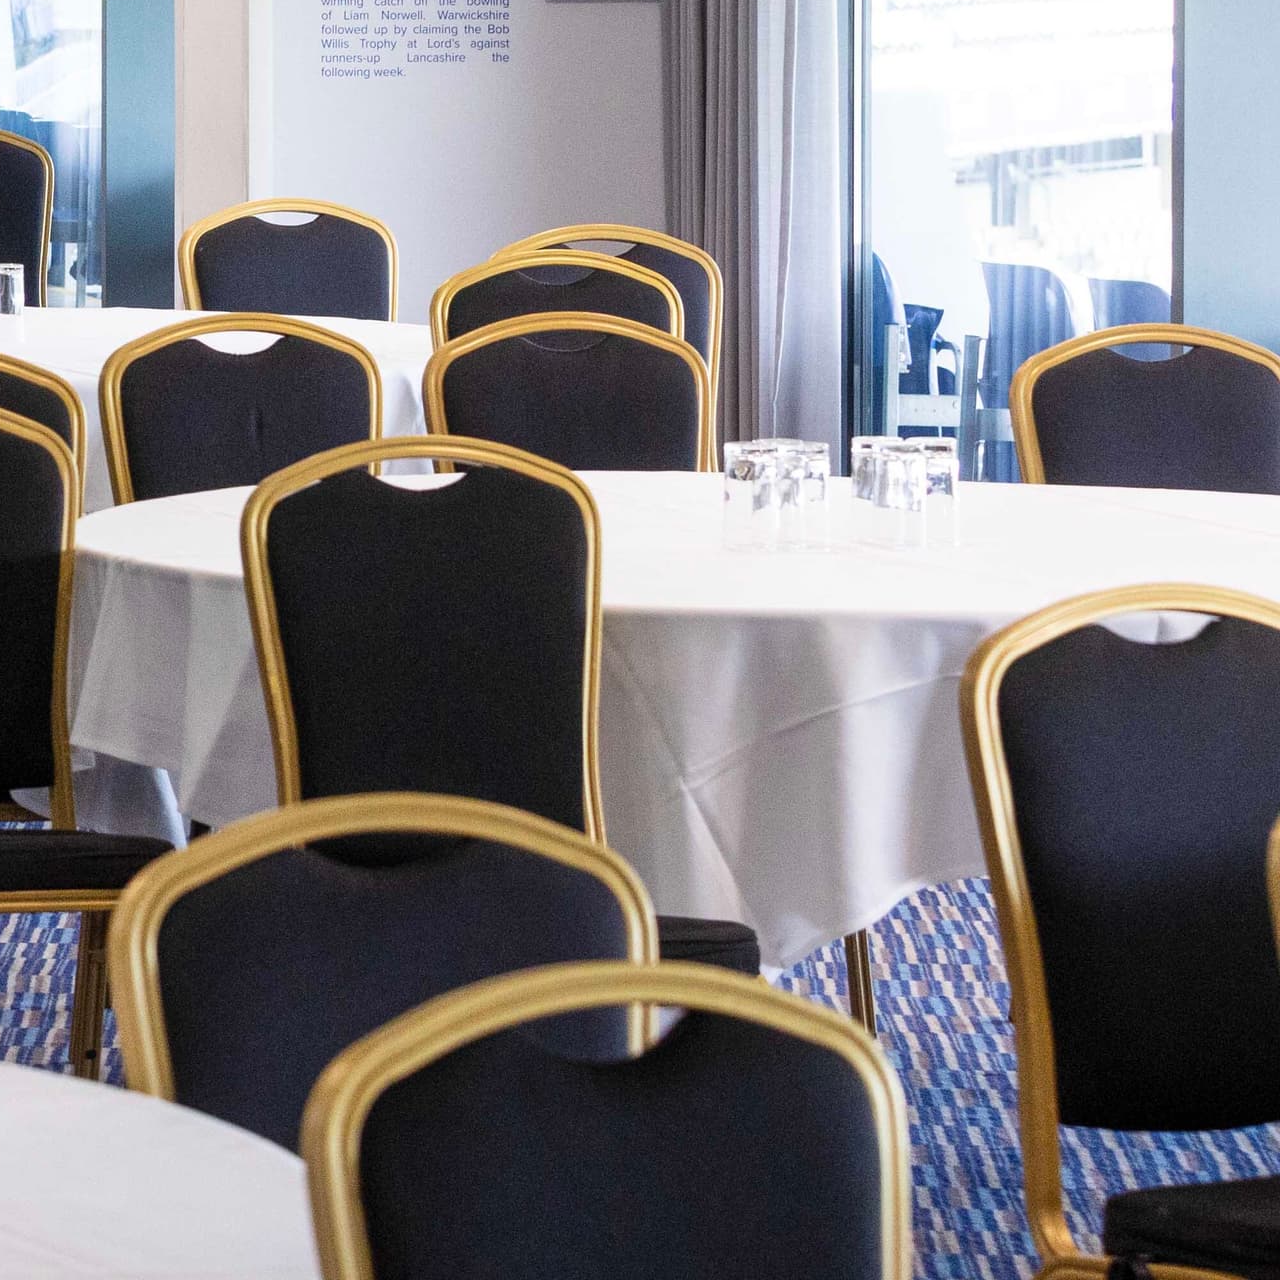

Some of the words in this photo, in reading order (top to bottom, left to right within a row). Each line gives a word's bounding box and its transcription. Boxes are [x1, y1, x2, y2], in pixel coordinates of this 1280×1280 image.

[321, 9, 332, 20] of
[343, 9, 369, 20] Liam
[437, 9, 510, 20] Warwickshire
[321, 24, 368, 34] followed
[374, 26, 388, 37] up
[393, 24, 408, 37] by
[412, 24, 458, 37] claiming
[464, 24, 482, 34] the
[487, 24, 510, 34] Bob
[321, 38, 350, 49] Willis
[359, 38, 397, 52] Trophy
[407, 38, 417, 49] at
[470, 38, 510, 52] against
[321, 55, 381, 66] runners-up
[407, 52, 466, 63] Lancashire
[491, 52, 510, 63] the
[321, 66, 371, 80] following
